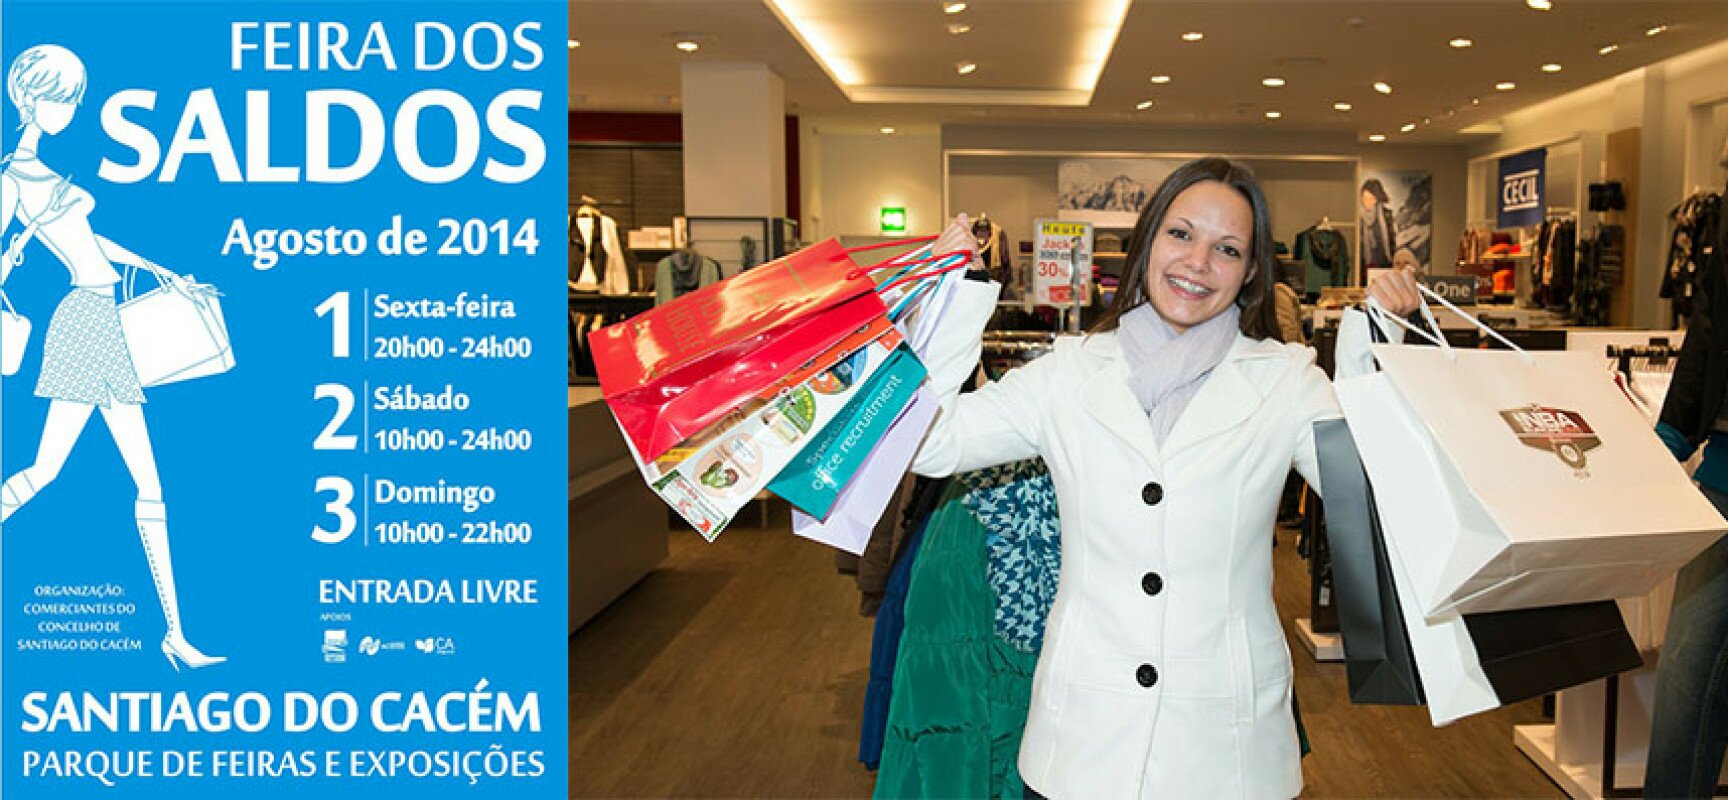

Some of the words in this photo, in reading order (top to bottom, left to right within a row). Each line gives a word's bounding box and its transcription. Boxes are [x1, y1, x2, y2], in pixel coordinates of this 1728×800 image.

[231, 21, 397, 71] FEIRA
[415, 21, 544, 71] DOS
[97, 88, 547, 183] SALDOS
[1504, 176, 1539, 204] CECIL
[221, 218, 368, 270] Agosto
[377, 214, 427, 256] de
[437, 218, 540, 257] 2014
[1433, 281, 1471, 298] One
[373, 291, 516, 319] Sexta-feira
[314, 291, 350, 358] 1
[373, 334, 445, 359] 20h00
[461, 334, 533, 359] 24h00
[373, 384, 470, 411] Sábado
[313, 382, 358, 450] 2
[840, 374, 902, 454] recruitment
[374, 426, 445, 451] 10h00
[461, 426, 533, 451] 24h00
[374, 479, 496, 512] Domingo
[311, 476, 357, 544] 3
[374, 519, 445, 544] 10h00
[461, 519, 533, 544] 22h00
[319, 579, 456, 604] ENTRADA
[461, 579, 539, 604] LIVRE
[23, 603, 115, 615] COMERCIANTES
[116, 603, 136, 615] DO
[37, 621, 103, 633] CONCELHO
[105, 621, 121, 633] DE
[17, 639, 77, 651] SANTIAGO
[79, 639, 98, 651] DO
[100, 637, 142, 651] CACÉM
[21, 691, 271, 733] SANTIAGO
[284, 691, 359, 733] DO
[370, 677, 541, 733] CACÉM
[23, 750, 154, 786] PARQUE
[162, 750, 203, 777] DE
[212, 750, 317, 777] FEIRAS
[326, 750, 342, 777] E
[350, 744, 545, 784] EXPOSIÇÕES
